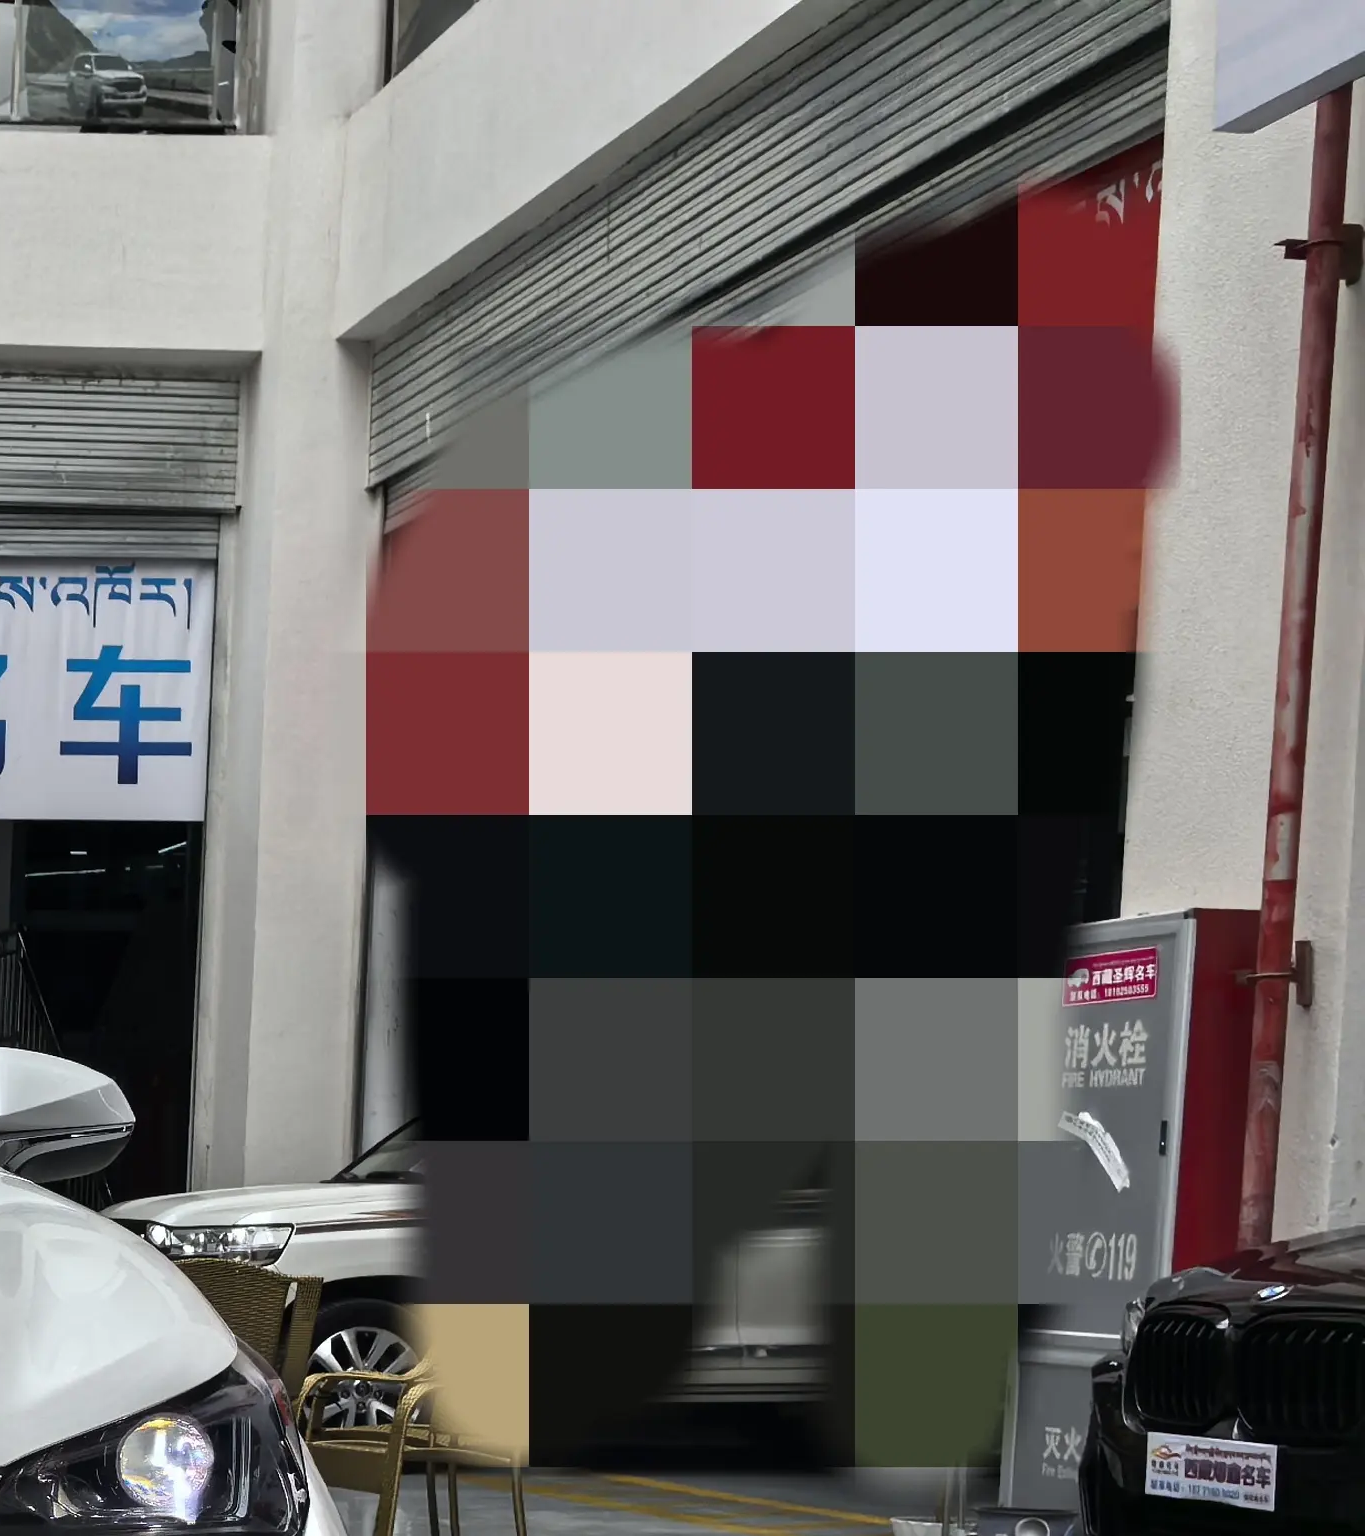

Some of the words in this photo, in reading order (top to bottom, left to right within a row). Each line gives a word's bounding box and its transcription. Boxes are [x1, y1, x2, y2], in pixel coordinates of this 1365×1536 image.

[1064, 1019, 1148, 1068] 消火栓
[1062, 1071, 1085, 1088] FIRE
[1089, 1067, 1146, 1087] HYDRANT
[1108, 1232, 1137, 1281] 119
